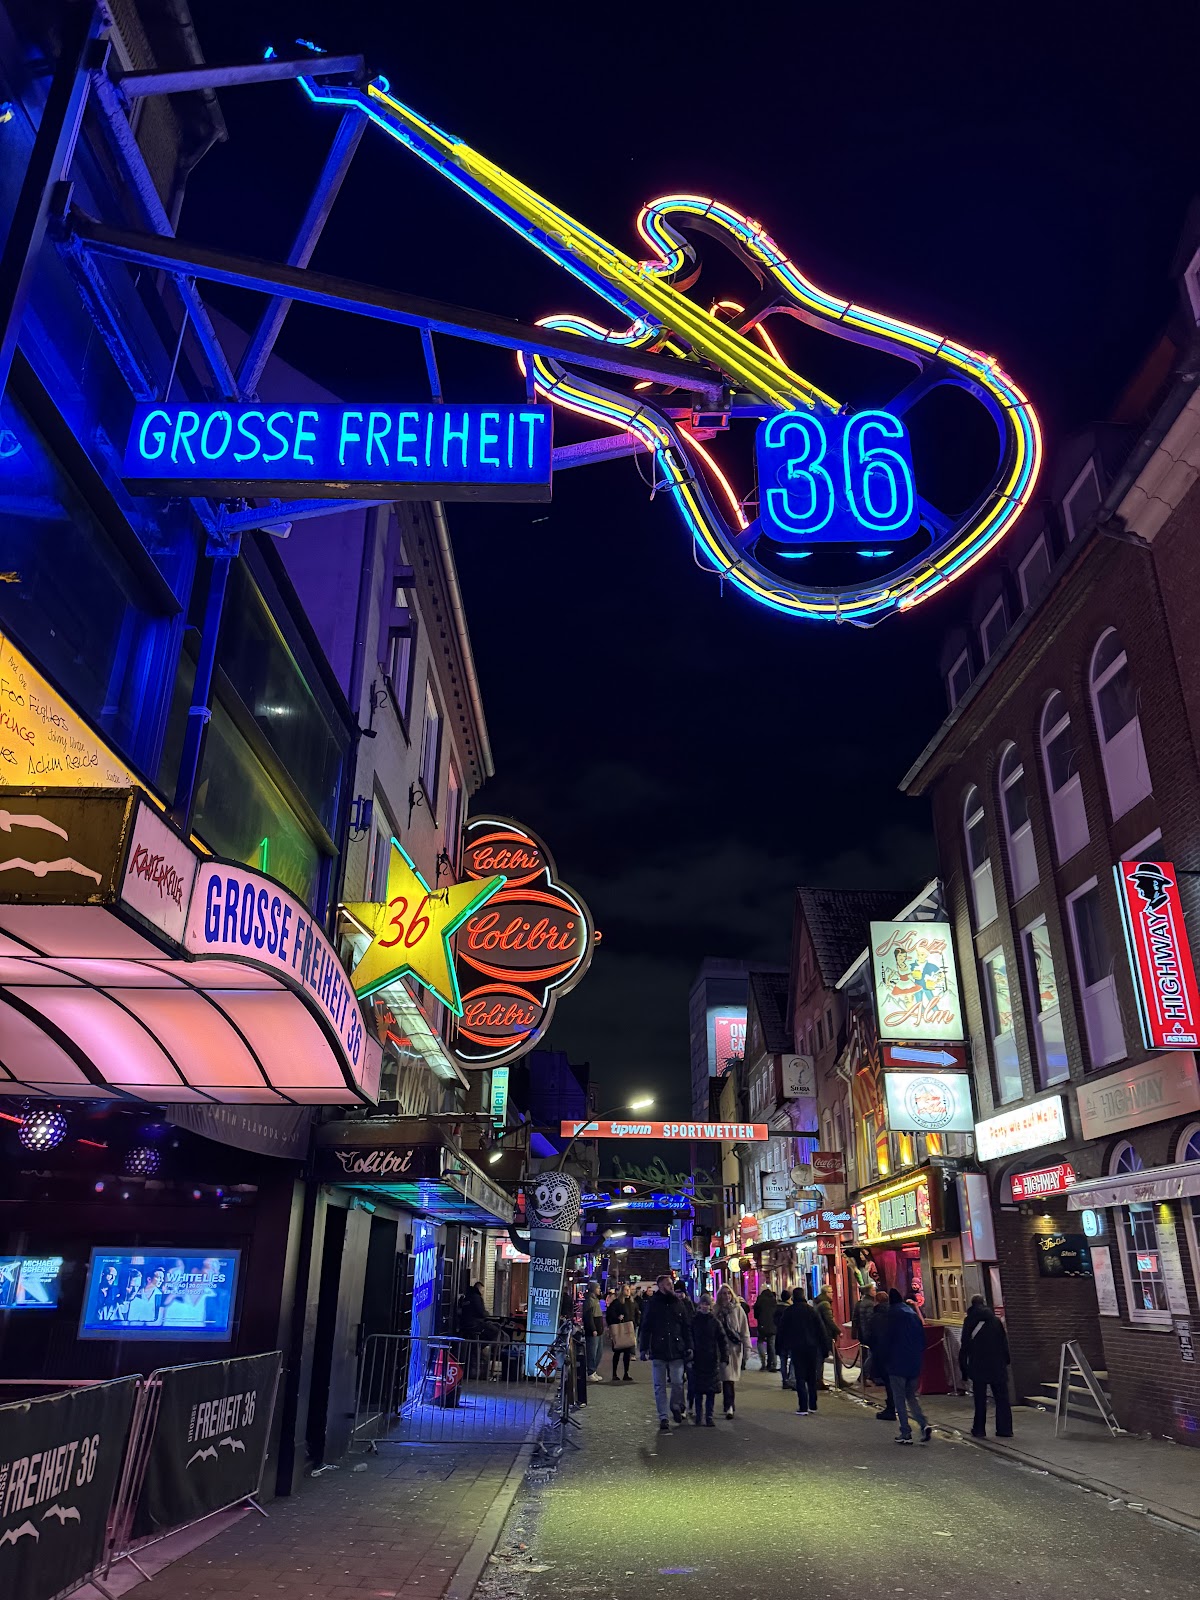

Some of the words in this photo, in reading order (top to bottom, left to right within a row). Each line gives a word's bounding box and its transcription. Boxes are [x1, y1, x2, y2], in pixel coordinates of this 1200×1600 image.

[137, 409, 320, 465] GROSSE
[338, 412, 545, 469] FREIHEIT
[764, 410, 915, 534] 36
[0, 703, 36, 747] rince
[472, 846, 540, 871] Colibri
[377, 895, 431, 949] 36
[466, 911, 578, 951] Colibri
[204, 874, 292, 963] GROSSE
[292, 914, 351, 1035] FREIHEIT
[346, 1007, 363, 1067] 36
[1148, 911, 1188, 1020] HIGHWAY
[465, 1000, 537, 1028] Colibri
[884, 996, 955, 1028] Alm
[1100, 1077, 1164, 1118] HIGHWAY
[610, 1123, 652, 1137] tipwin
[663, 1124, 755, 1139] SPORTWETTEN
[1022, 1170, 1061, 1195] HIGHWAY
[166, 1273, 202, 1283] WHITE
[203, 1273, 226, 1283] LIES
[529, 1287, 560, 1299] EINTRITT
[534, 1297, 551, 1307] FREI
[534, 1312, 549, 1320] FREE
[532, 1318, 552, 1327] ENTRY
[194, 1394, 243, 1442] FREIHEIT
[241, 1390, 257, 1427] 36
[2, 1440, 79, 1518] FREIHEIT
[76, 1434, 100, 1487] 36
